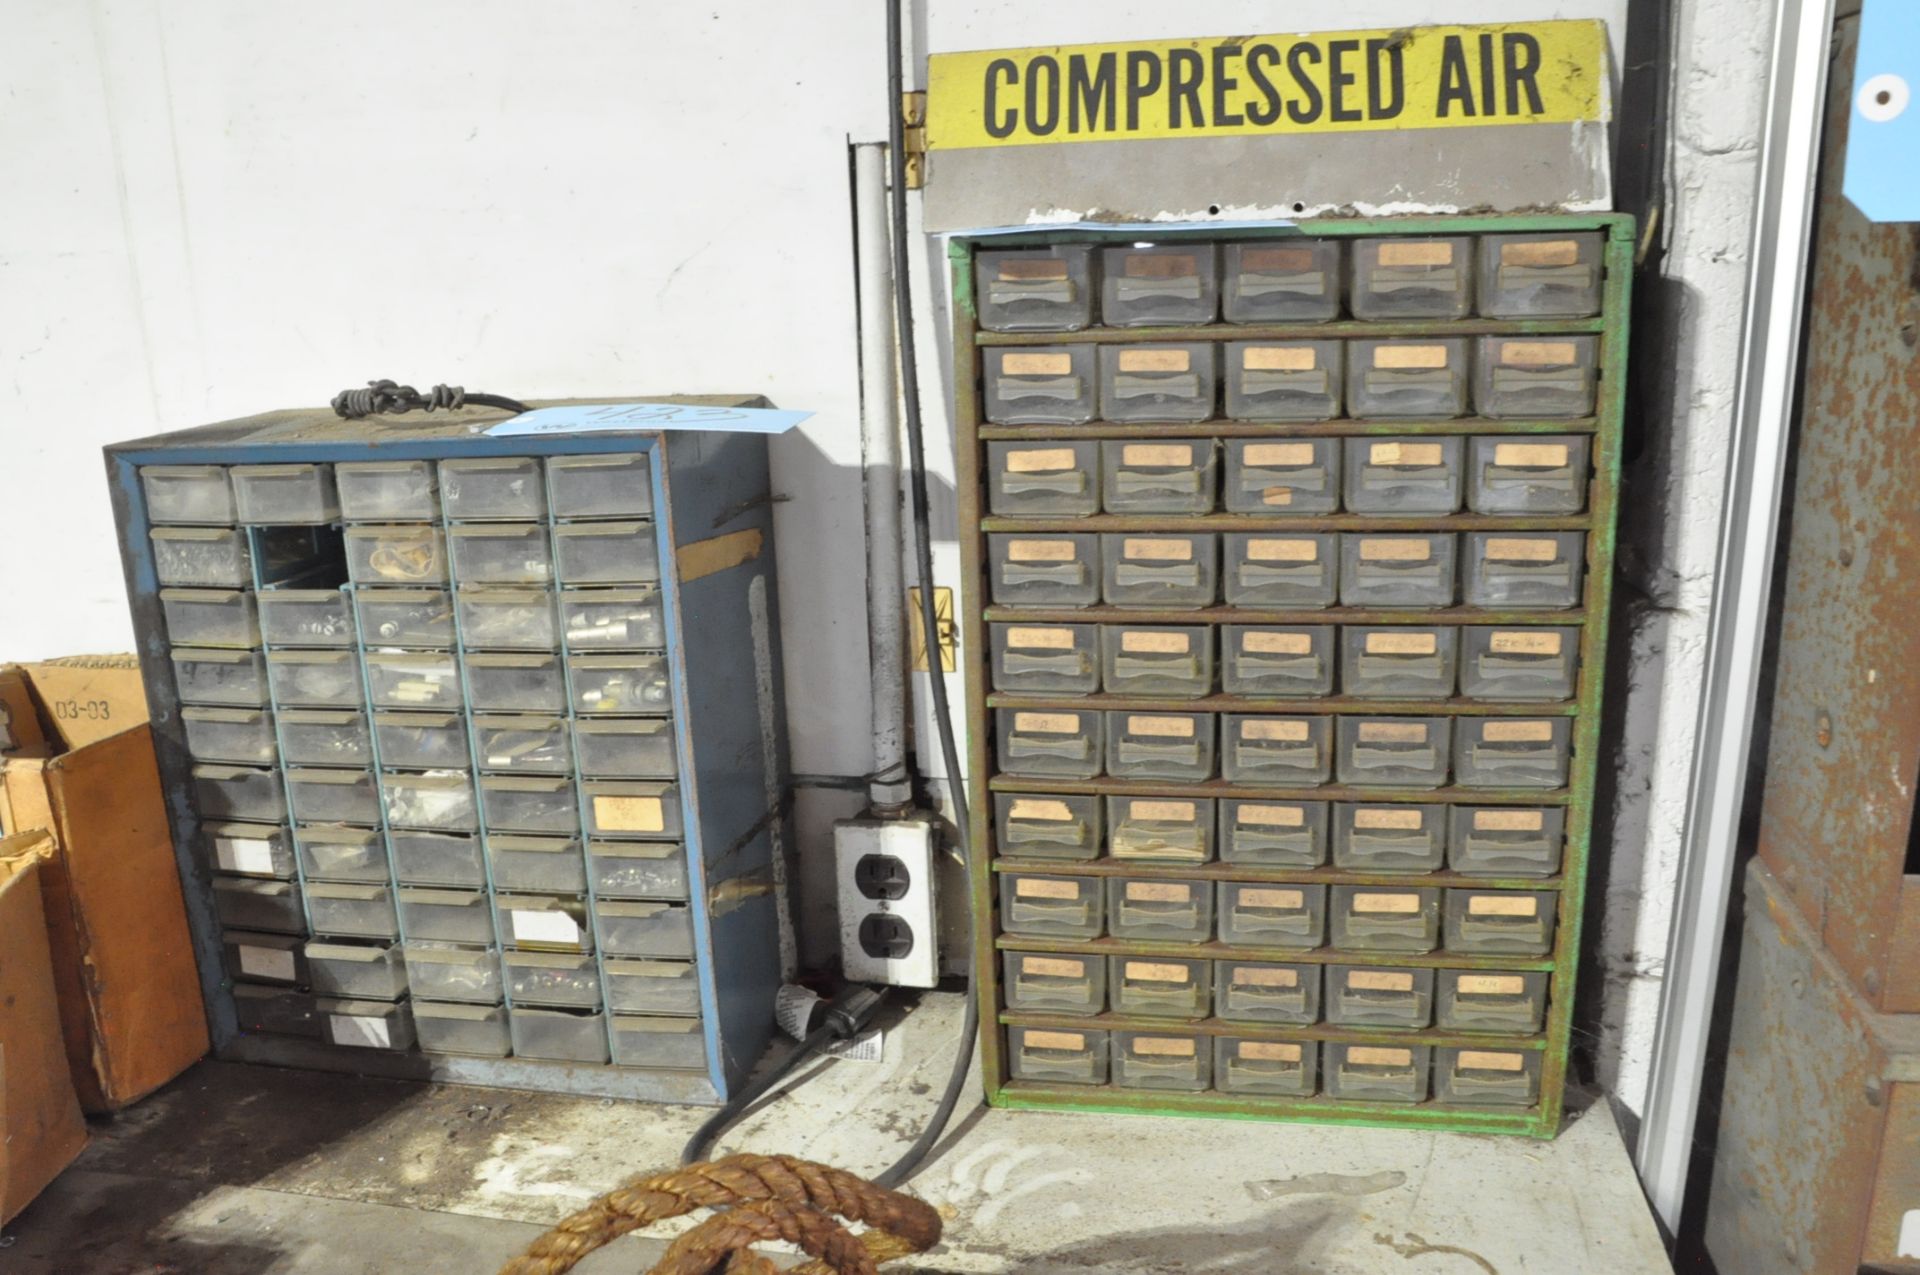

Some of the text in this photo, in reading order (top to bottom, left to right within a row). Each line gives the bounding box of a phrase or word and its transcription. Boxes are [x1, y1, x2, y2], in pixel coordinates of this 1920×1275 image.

[984, 32, 1544, 138] COMPRESSED AIR
[56, 700, 111, 720] 03-03
